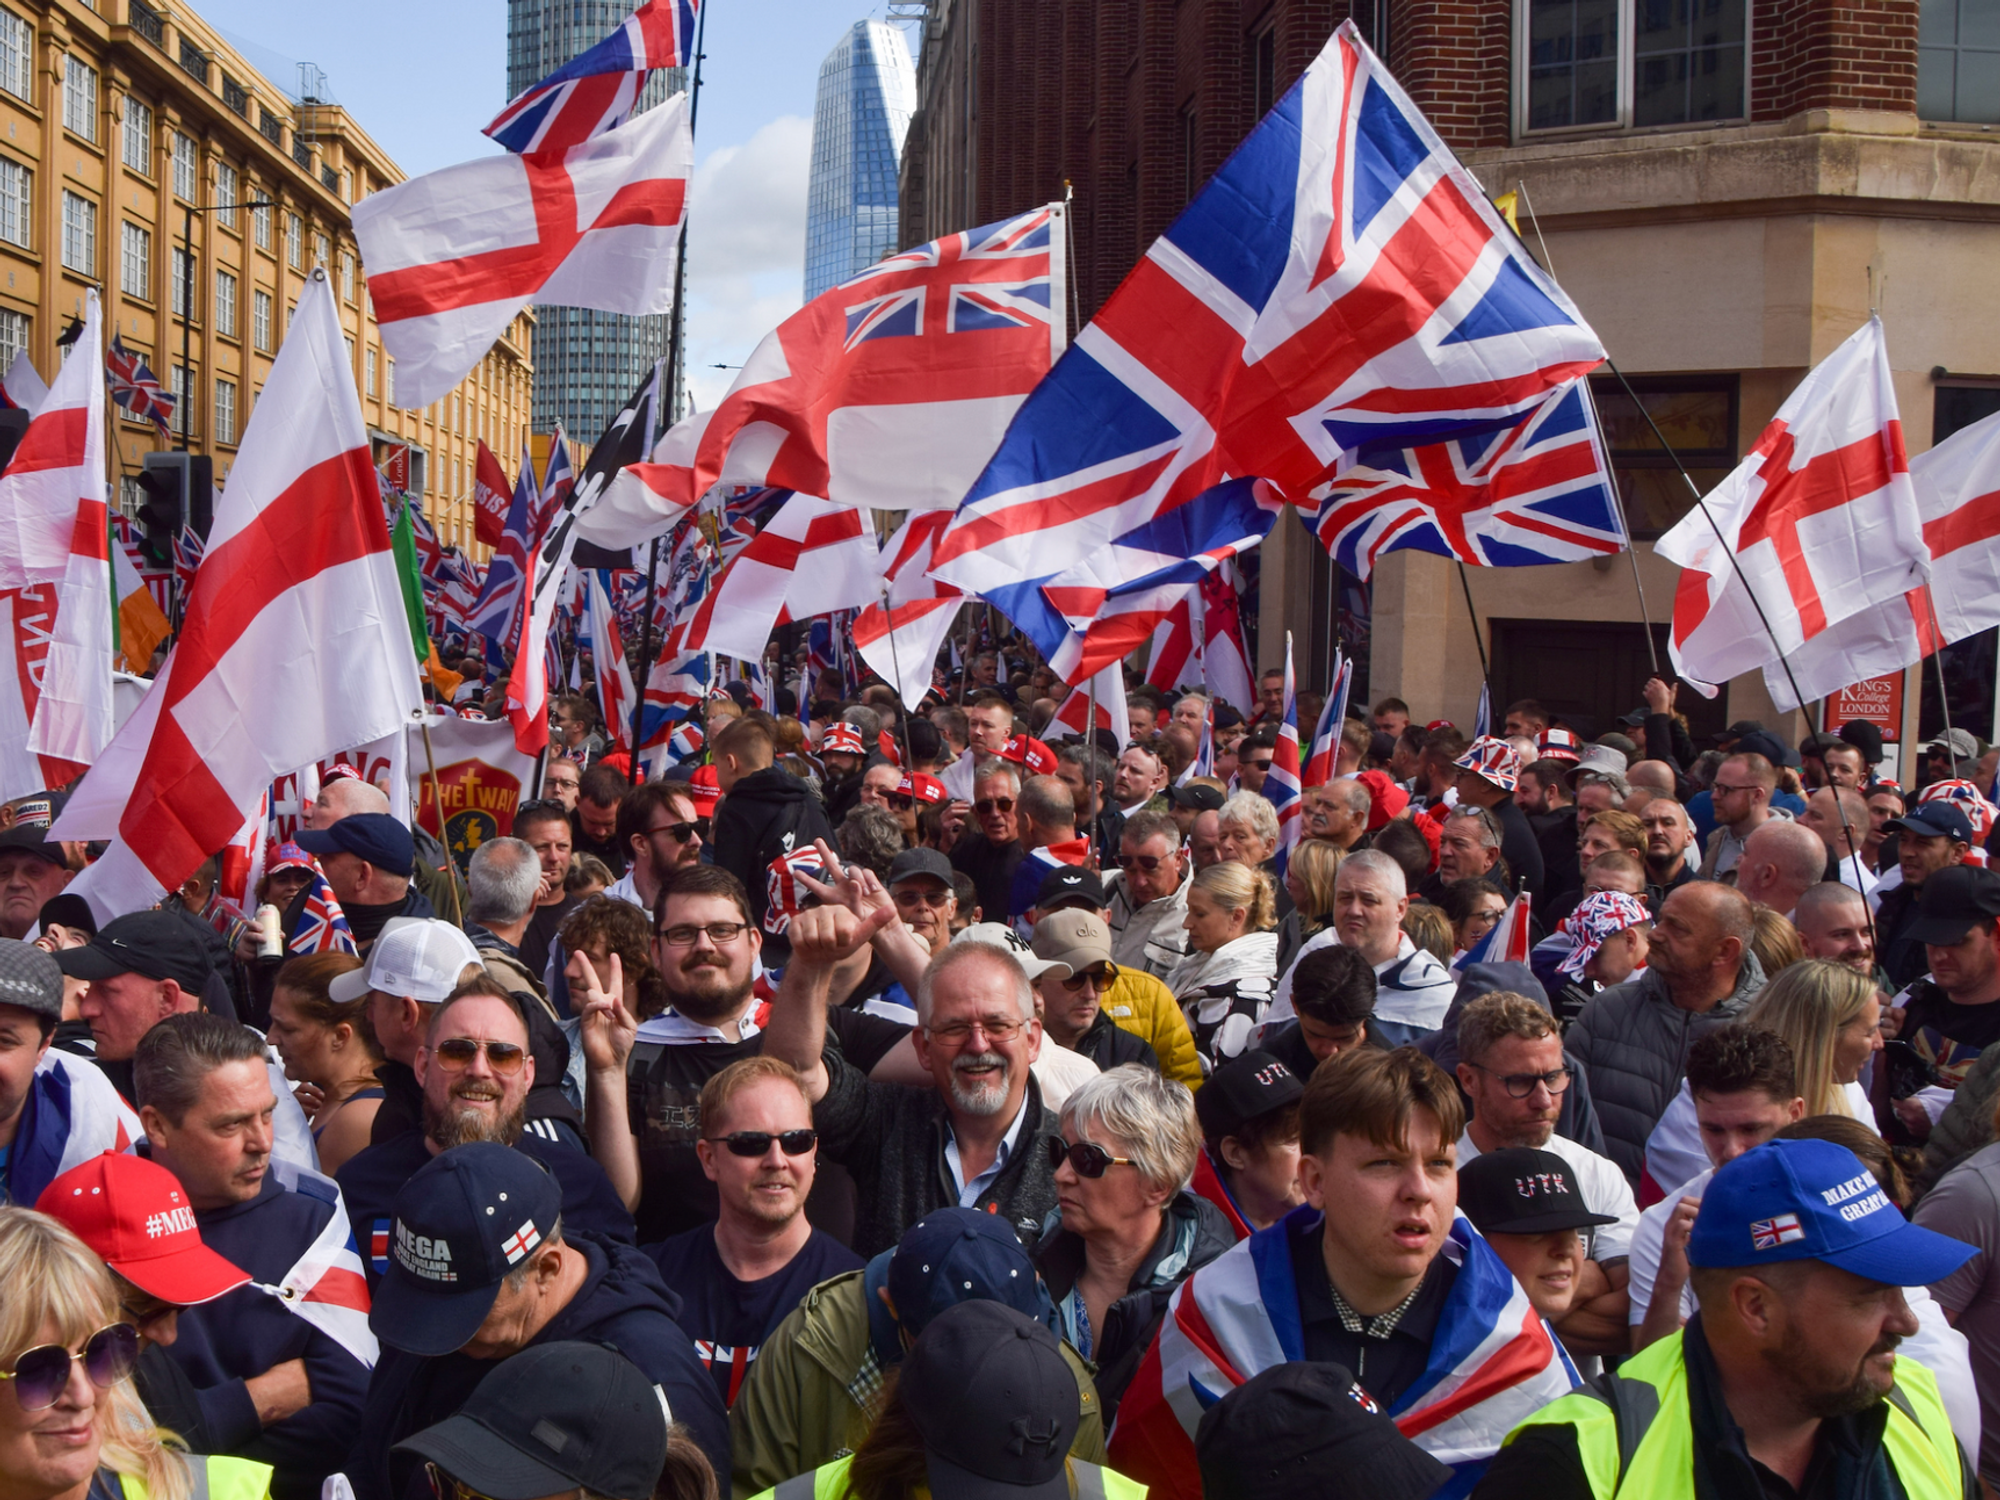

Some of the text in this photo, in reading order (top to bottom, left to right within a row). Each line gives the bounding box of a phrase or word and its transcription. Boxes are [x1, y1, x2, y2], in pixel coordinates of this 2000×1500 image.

[1840, 681, 1892, 702] KING'S
[1857, 692, 1890, 704] College
[1839, 703, 1890, 714] LONDON
[424, 781, 517, 813] THE WAY
[1076, 923, 1099, 938] alo
[1821, 1176, 1868, 1207] MAKE
[1840, 1193, 1883, 1222] GREAT
[396, 1216, 453, 1262] MEGA
[411, 1254, 449, 1272] ENGLAND
